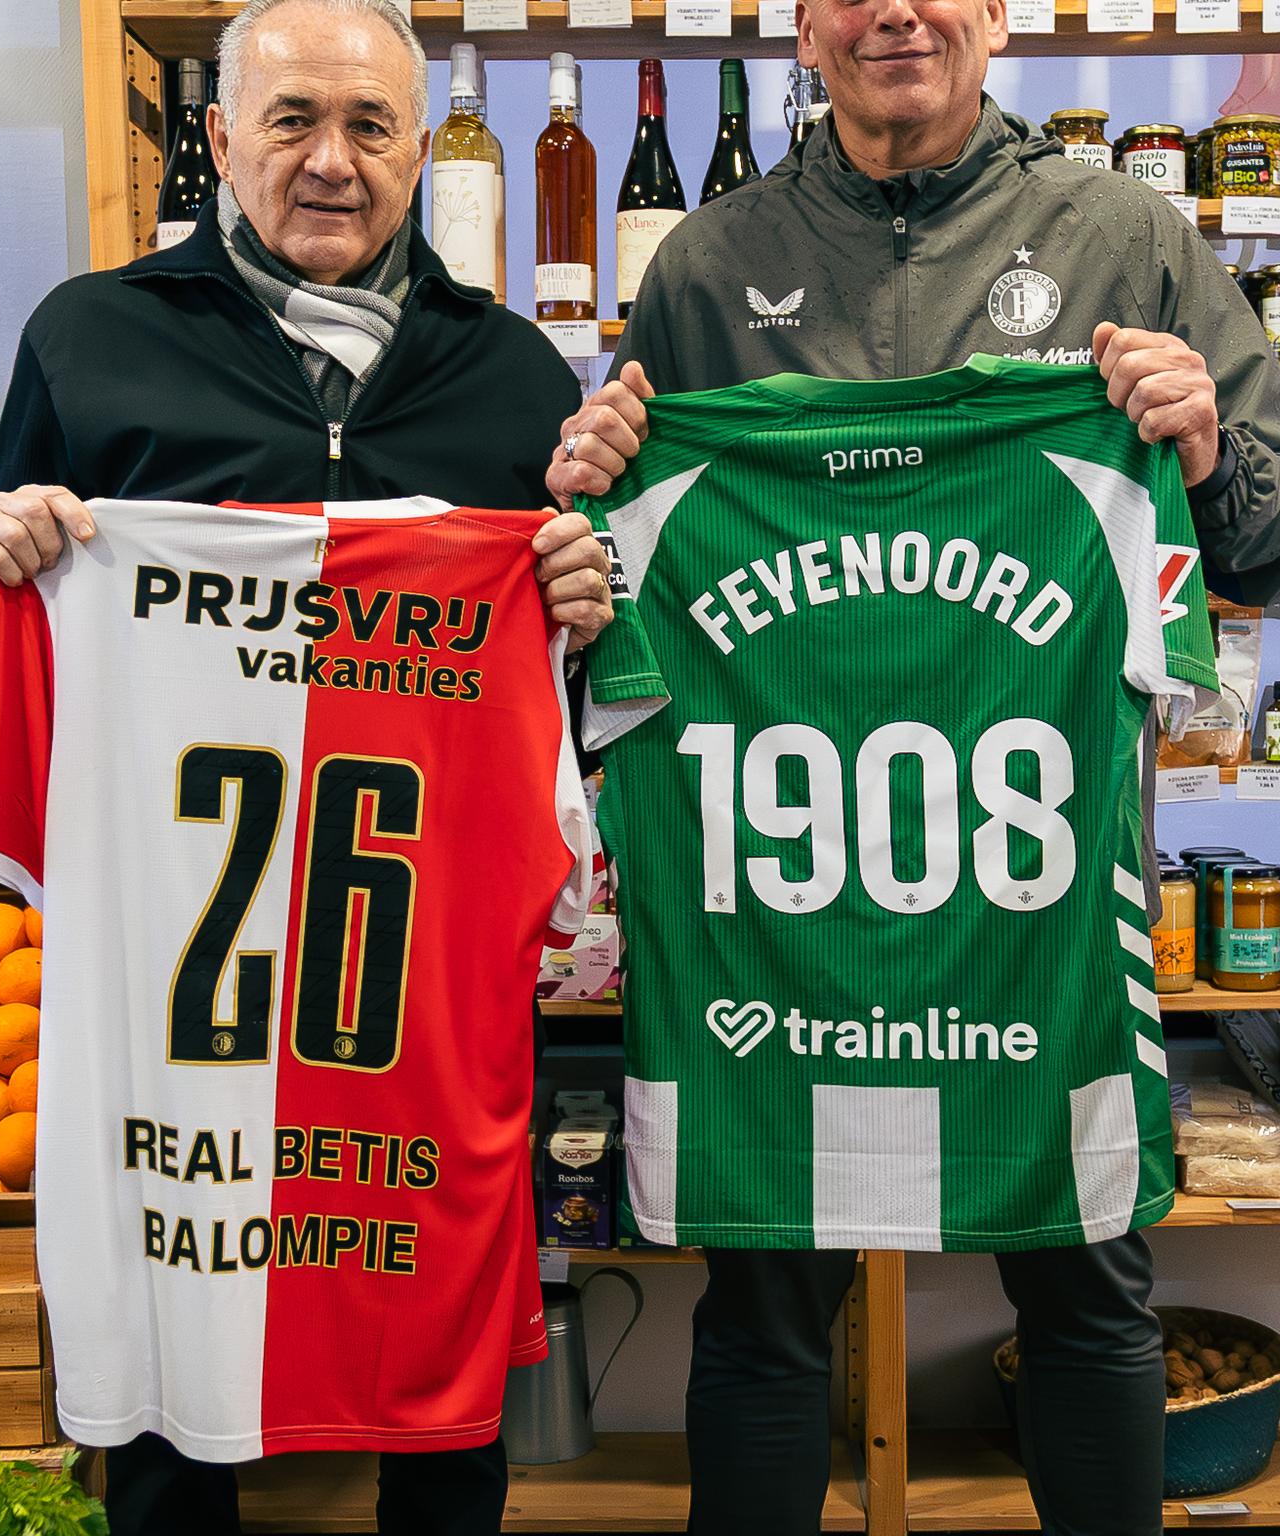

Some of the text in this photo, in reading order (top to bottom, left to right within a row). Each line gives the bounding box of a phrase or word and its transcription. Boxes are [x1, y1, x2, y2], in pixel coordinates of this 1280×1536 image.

[1073, 147, 1106, 156] ekolo
[1132, 151, 1168, 162] ekolo
[1226, 158, 1265, 168] GUISANTES
[1132, 162, 1167, 179] BIO
[994, 271, 1055, 295] FEYENOORD
[747, 318, 802, 330] CASTORE
[994, 308, 1055, 334] ROTTERDAM
[1041, 346, 1093, 365] Markt
[821, 444, 923, 478] prima
[689, 530, 1074, 655] FEYENOORD
[236, 641, 483, 702] vakanties
[675, 717, 1078, 914] 1908
[166, 741, 426, 1075] 26
[1230, 933, 1240, 941] Miel
[783, 1006, 1039, 1061] trainline
[122, 1116, 440, 1190] REAL BETIS
[558, 1174, 595, 1183] Rooibos
